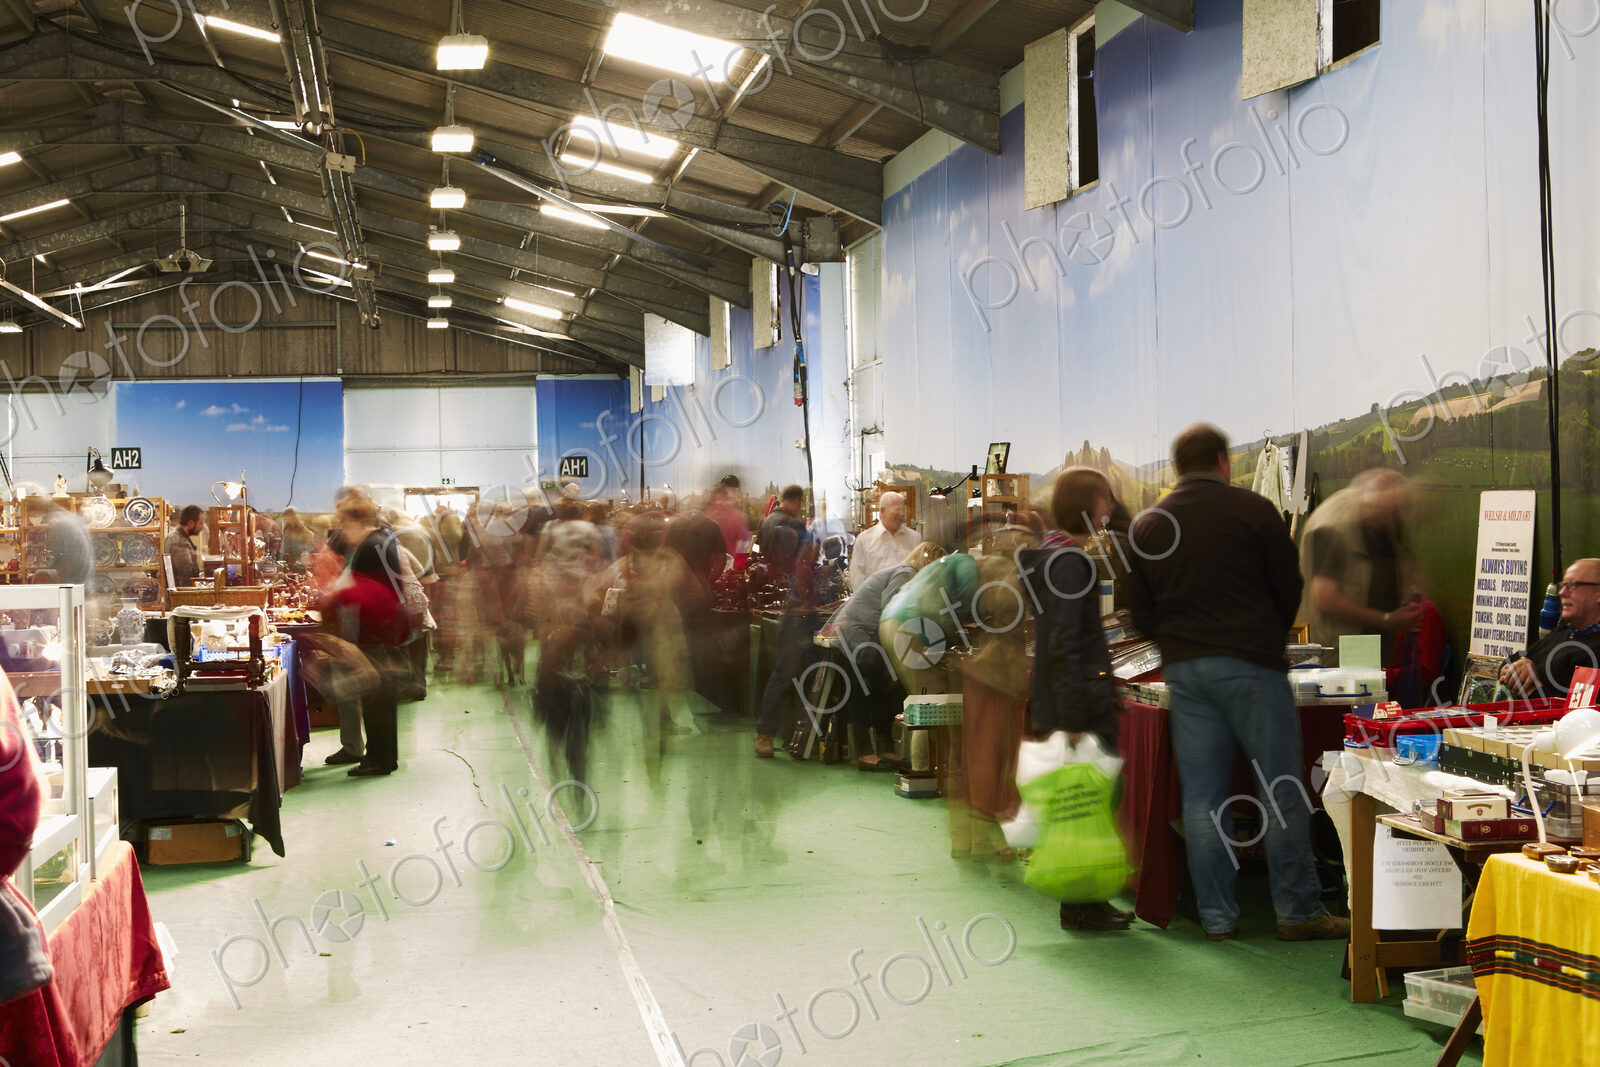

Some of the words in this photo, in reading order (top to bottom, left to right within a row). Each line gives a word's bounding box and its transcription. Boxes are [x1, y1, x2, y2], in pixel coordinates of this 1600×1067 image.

[113, 449, 140, 468] AH2
[561, 458, 587, 476] AH1
[1481, 558, 1505, 574] ALWAYS
[1505, 560, 1527, 576] BUYING
[1501, 580, 1528, 593] POSTCARDS
[1476, 595, 1493, 607] MINING
[1510, 597, 1527, 610] CHECKS
[1515, 614, 1526, 627] GOLD
[1473, 627, 1483, 639] AND
[1483, 628, 1492, 640] ANY
[1492, 629, 1506, 641] ITEMS
[1506, 630, 1526, 644] RELATING
[1484, 644, 1490, 655] TO
[1490, 645, 1499, 656] THE
